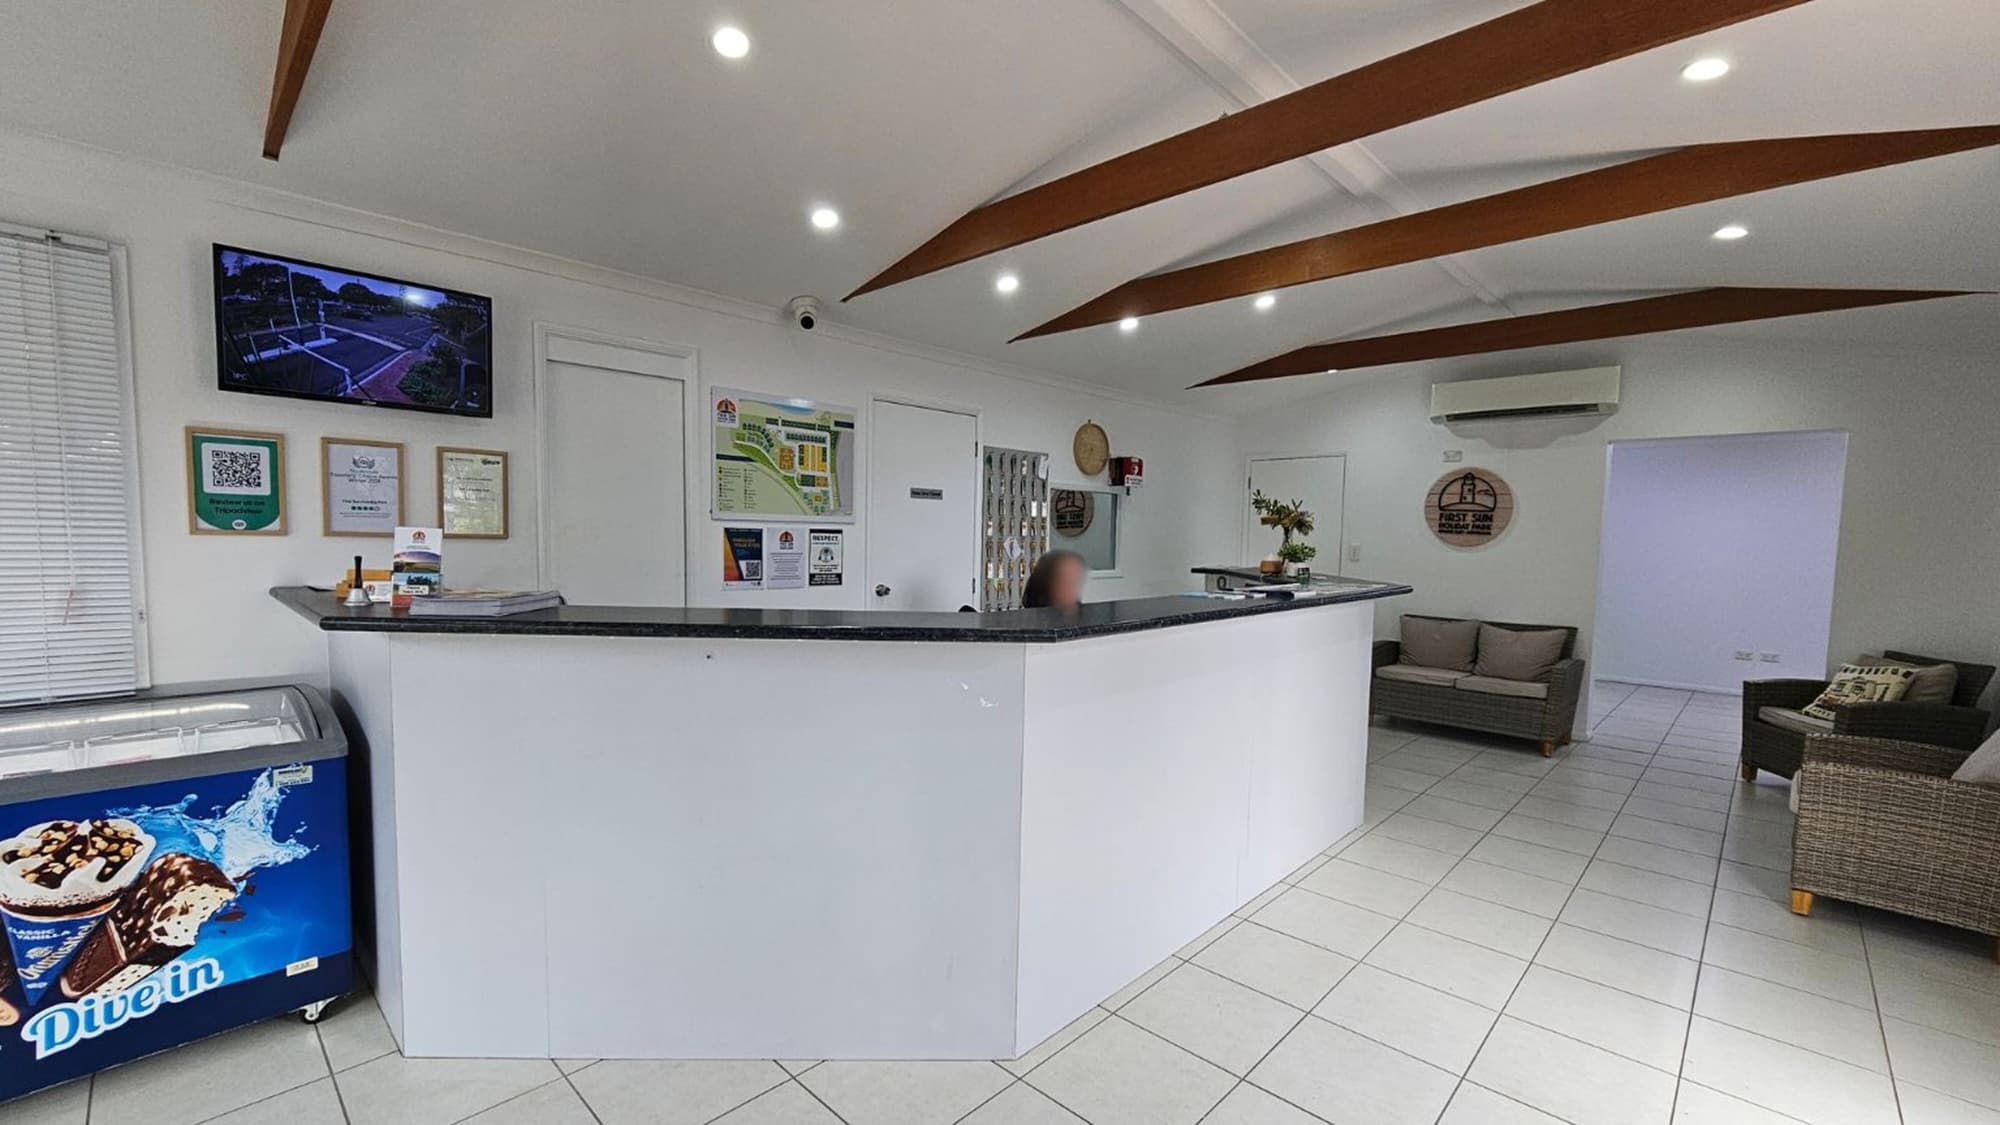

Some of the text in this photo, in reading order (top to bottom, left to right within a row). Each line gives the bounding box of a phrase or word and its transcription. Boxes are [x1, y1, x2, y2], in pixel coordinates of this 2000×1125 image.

[208, 498, 241, 506] Review
[1438, 513, 1494, 523] FIRST SUN
[1438, 522, 1470, 530] HOLIDAY
[27, 961, 220, 1054] Dive in
